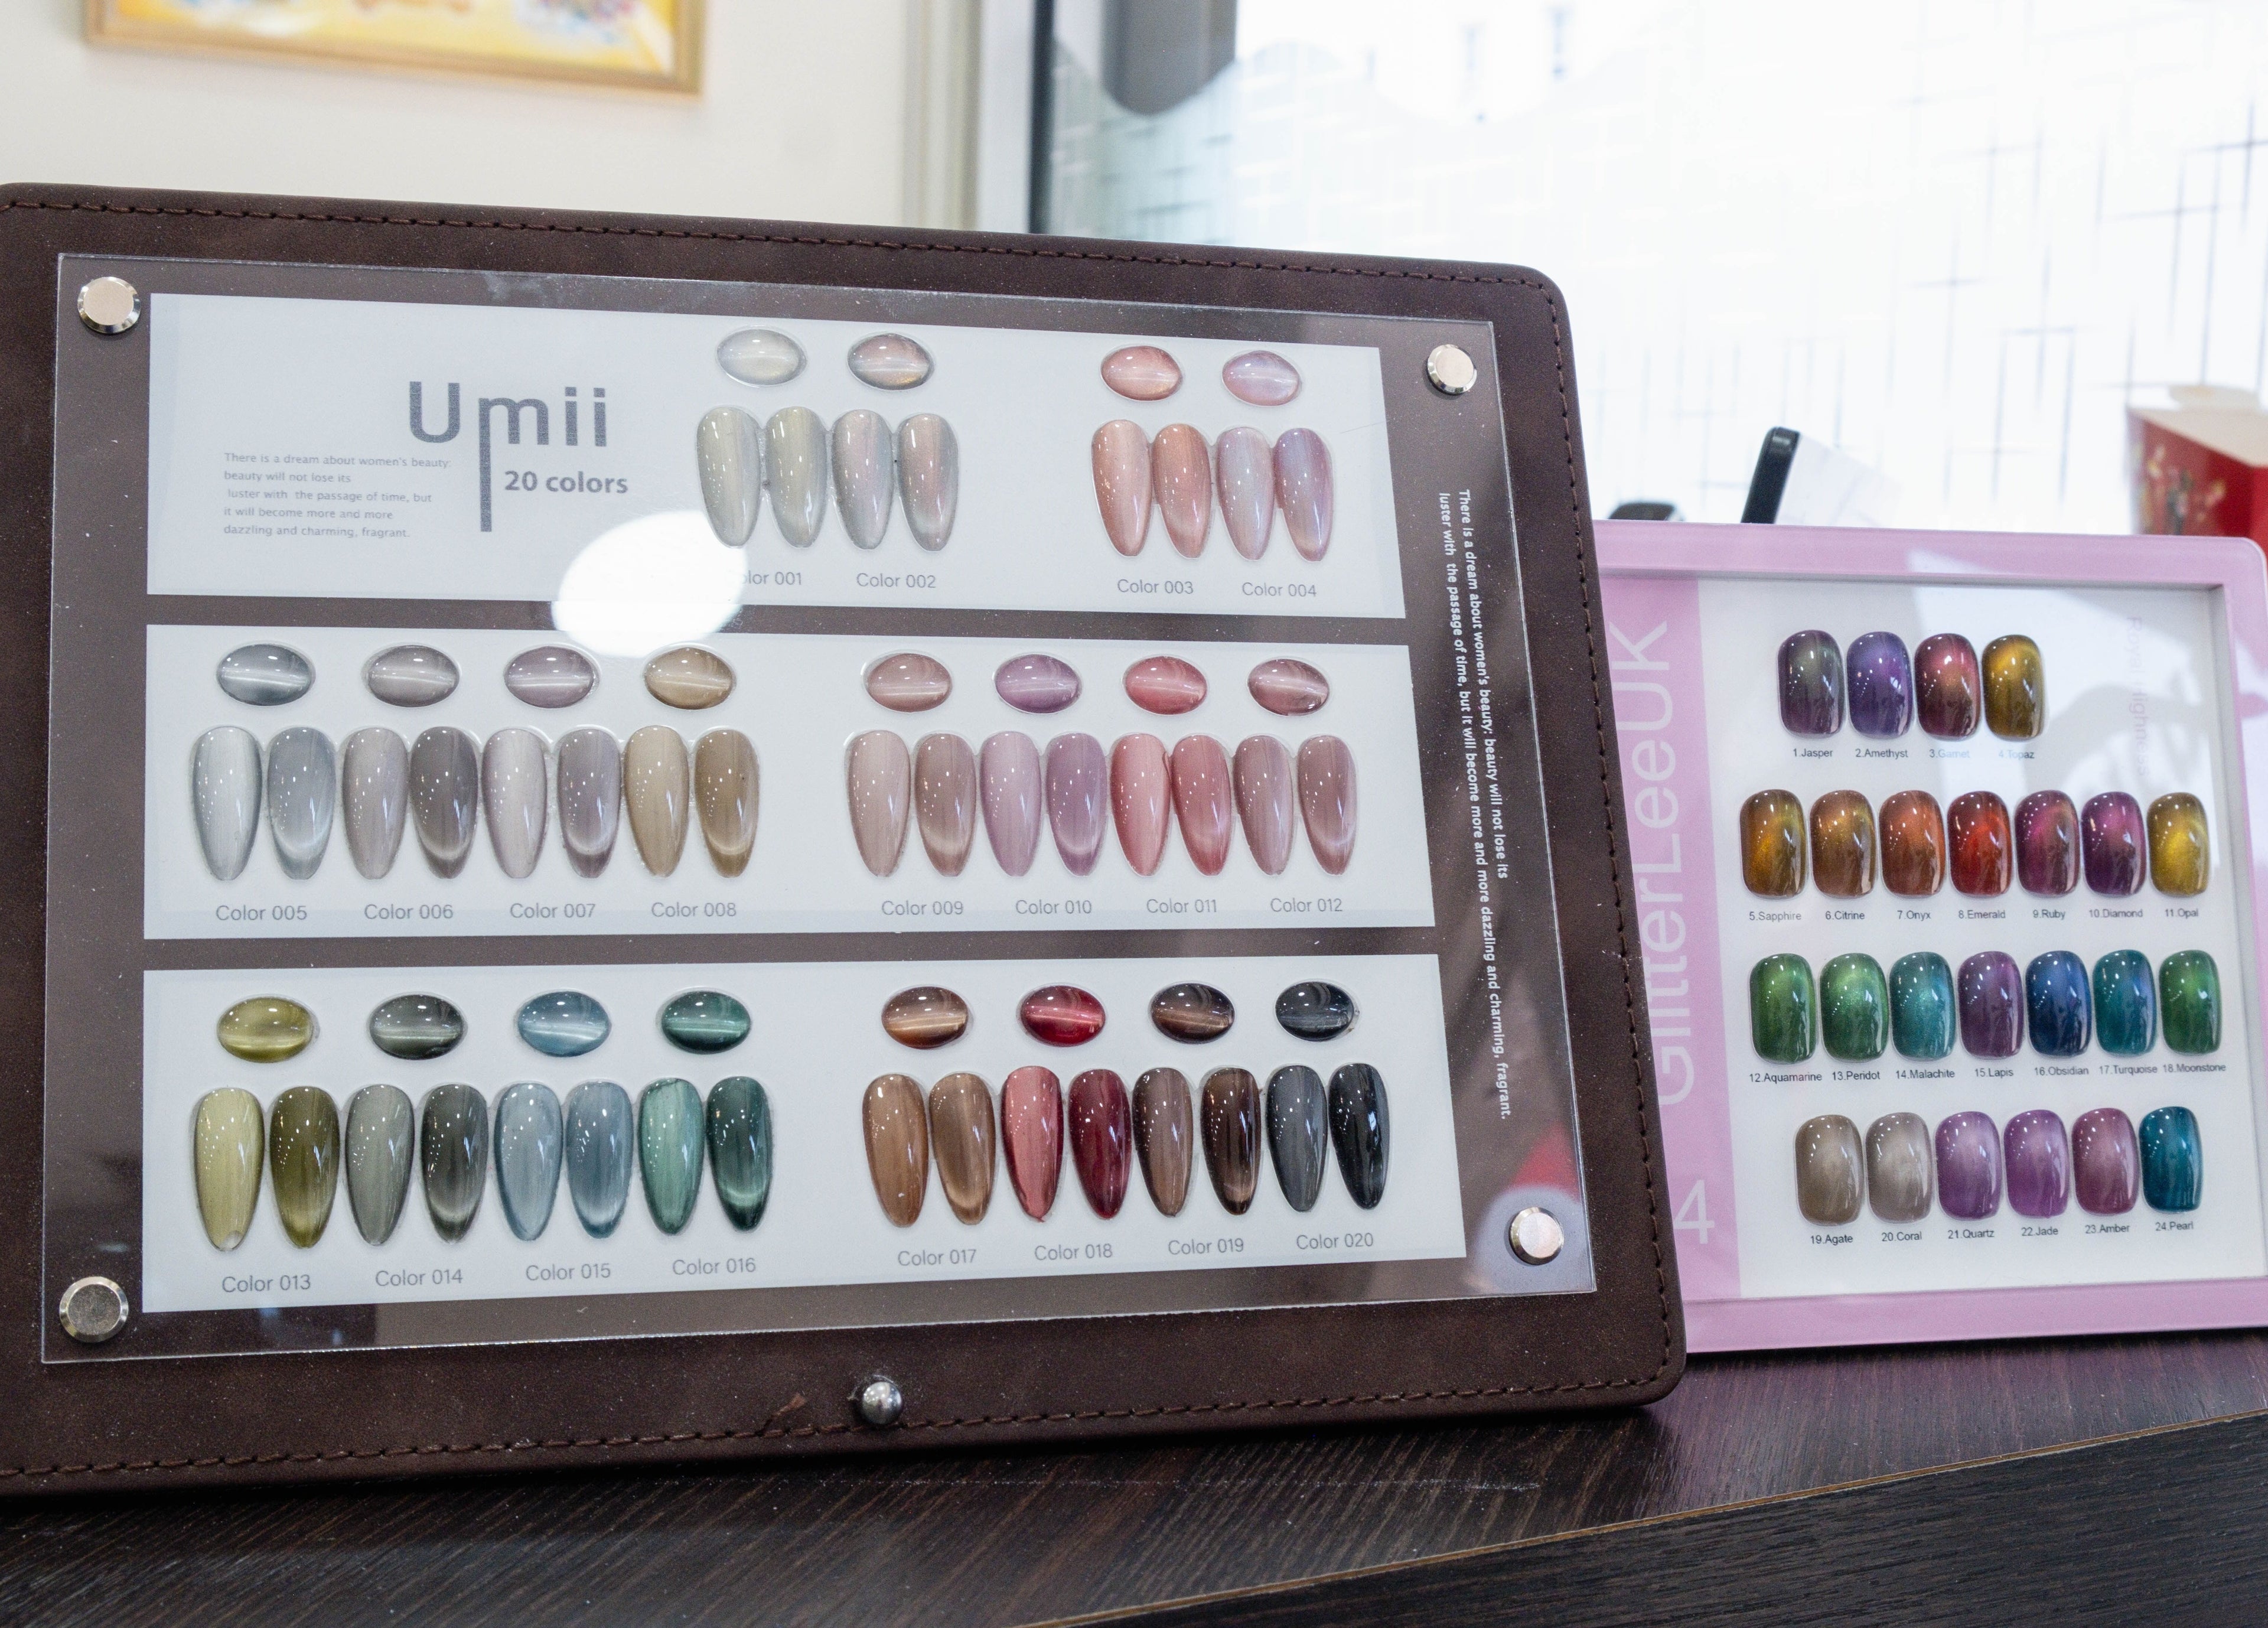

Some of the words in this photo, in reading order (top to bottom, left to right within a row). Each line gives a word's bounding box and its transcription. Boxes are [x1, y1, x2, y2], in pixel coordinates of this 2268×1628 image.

[224, 452, 257, 463] There
[260, 454, 270, 463] is
[273, 455, 281, 464] a
[283, 454, 320, 464] dream
[322, 455, 356, 465] about
[409, 381, 607, 532] Umii
[223, 470, 263, 482] beauty
[265, 471, 285, 481] will
[289, 474, 308, 482] not
[311, 473, 334, 483] lose
[337, 474, 351, 483] its
[504, 470, 538, 491] 20
[545, 471, 628, 494] colors
[227, 489, 260, 499] luster
[263, 490, 288, 499] with
[295, 490, 314, 500] the
[317, 492, 363, 503] passage
[366, 491, 378, 502] of
[413, 493, 432, 503] but
[223, 507, 232, 516] it
[234, 507, 255, 516] will
[258, 507, 303, 517] become
[307, 510, 336, 519] more
[339, 510, 361, 519] and
[364, 512, 393, 520] more
[1439, 493, 1452, 528] luster
[1459, 489, 1471, 523] There
[223, 524, 273, 538] dazzling
[276, 526, 298, 535] and
[1462, 528, 1474, 537] is
[1443, 529, 1457, 556] with
[774, 571, 802, 586] 001
[1446, 563, 1458, 583] the
[1465, 551, 1478, 590] dream
[856, 572, 901, 588] Color
[905, 574, 936, 589] 002
[1116, 578, 1159, 594] Color
[1164, 580, 1194, 595] 003
[1241, 581, 1283, 597] Color
[1288, 583, 1317, 597] 004
[1446, 587, 1463, 636] passage
[1469, 593, 1483, 629] about
[1454, 639, 1467, 653] of
[1459, 691, 1471, 712] but
[1462, 715, 1473, 724] it
[1462, 727, 1477, 749] will
[1484, 738, 1498, 783] beauty
[1793, 748, 1833, 759] 1.Jasper
[1855, 748, 1908, 760] 2.Amethyst
[1928, 748, 1970, 759] 3.Garnet
[1998, 750, 2035, 761] 4.Topaz
[1465, 753, 1480, 802] become
[1489, 783, 1503, 805] will
[1471, 806, 1483, 838] more
[1491, 809, 1504, 830] not
[1474, 842, 1488, 865] and
[1494, 833, 1506, 859] lose
[1497, 864, 1508, 879] its
[1477, 870, 1490, 903] more
[215, 904, 266, 922] Color
[271, 905, 308, 921] 005
[363, 903, 414, 920] Color
[418, 904, 454, 920] 006
[509, 902, 558, 919] Color
[563, 903, 597, 919] 007
[650, 901, 699, 918] Color
[703, 901, 737, 918] 008
[881, 900, 927, 916] Color
[931, 900, 964, 916] 009
[1015, 898, 1060, 915] Color
[1064, 900, 1093, 915] 010
[1146, 898, 1190, 914] Color
[1194, 898, 1217, 914] 011
[1269, 897, 1312, 913] Color
[1317, 897, 1343, 913] 012
[1748, 910, 1802, 923] 5.Sapphire
[1824, 910, 1865, 920] 6.Citrine
[1896, 909, 1931, 922] 7.Onyx
[1958, 909, 2006, 920] 8.Emerald
[2032, 909, 2066, 920] 9.Ruby
[2088, 908, 2143, 919] 10.Diamond
[2165, 908, 2199, 920] 11.Opal
[1480, 906, 1496, 961] dazzling
[1487, 965, 1501, 989] and
[1832, 1070, 1881, 1081] 13.Peridot
[1895, 1069, 1956, 1079] 14.Malachite
[1974, 1067, 2014, 1079] 15.Lapis
[2034, 1066, 2090, 1076] 16.Obsidian
[2099, 1064, 2158, 1076] 17.Turquoise
[2163, 1063, 2227, 1073] 18.Moonstone
[1749, 1072, 1823, 1085] 12.Aquamarine
[1673, 1180, 1715, 1244] 4
[1947, 1229, 1995, 1240] 21.Quartz
[2021, 1226, 2059, 1237] 22.Jade
[2085, 1224, 2130, 1235] 23.Amber
[2155, 1221, 2194, 1232] 24.Pearl
[1295, 1233, 1340, 1250] Color
[1344, 1232, 1374, 1248] 020
[1810, 1234, 1854, 1246] 19.Agate
[1881, 1231, 1922, 1242] 20.Coral
[1034, 1244, 1080, 1261] Color
[1084, 1243, 1113, 1259] 018
[1167, 1238, 1213, 1255] Color
[1217, 1237, 1244, 1253] 019
[897, 1249, 944, 1266] Color
[949, 1248, 977, 1265] 017
[525, 1264, 575, 1281] Color
[580, 1262, 611, 1279] 015
[672, 1258, 721, 1276] Color
[725, 1256, 757, 1274] 016
[221, 1274, 273, 1293] Color
[279, 1274, 311, 1291] 013
[374, 1269, 426, 1287] Color
[431, 1268, 464, 1285] 014
